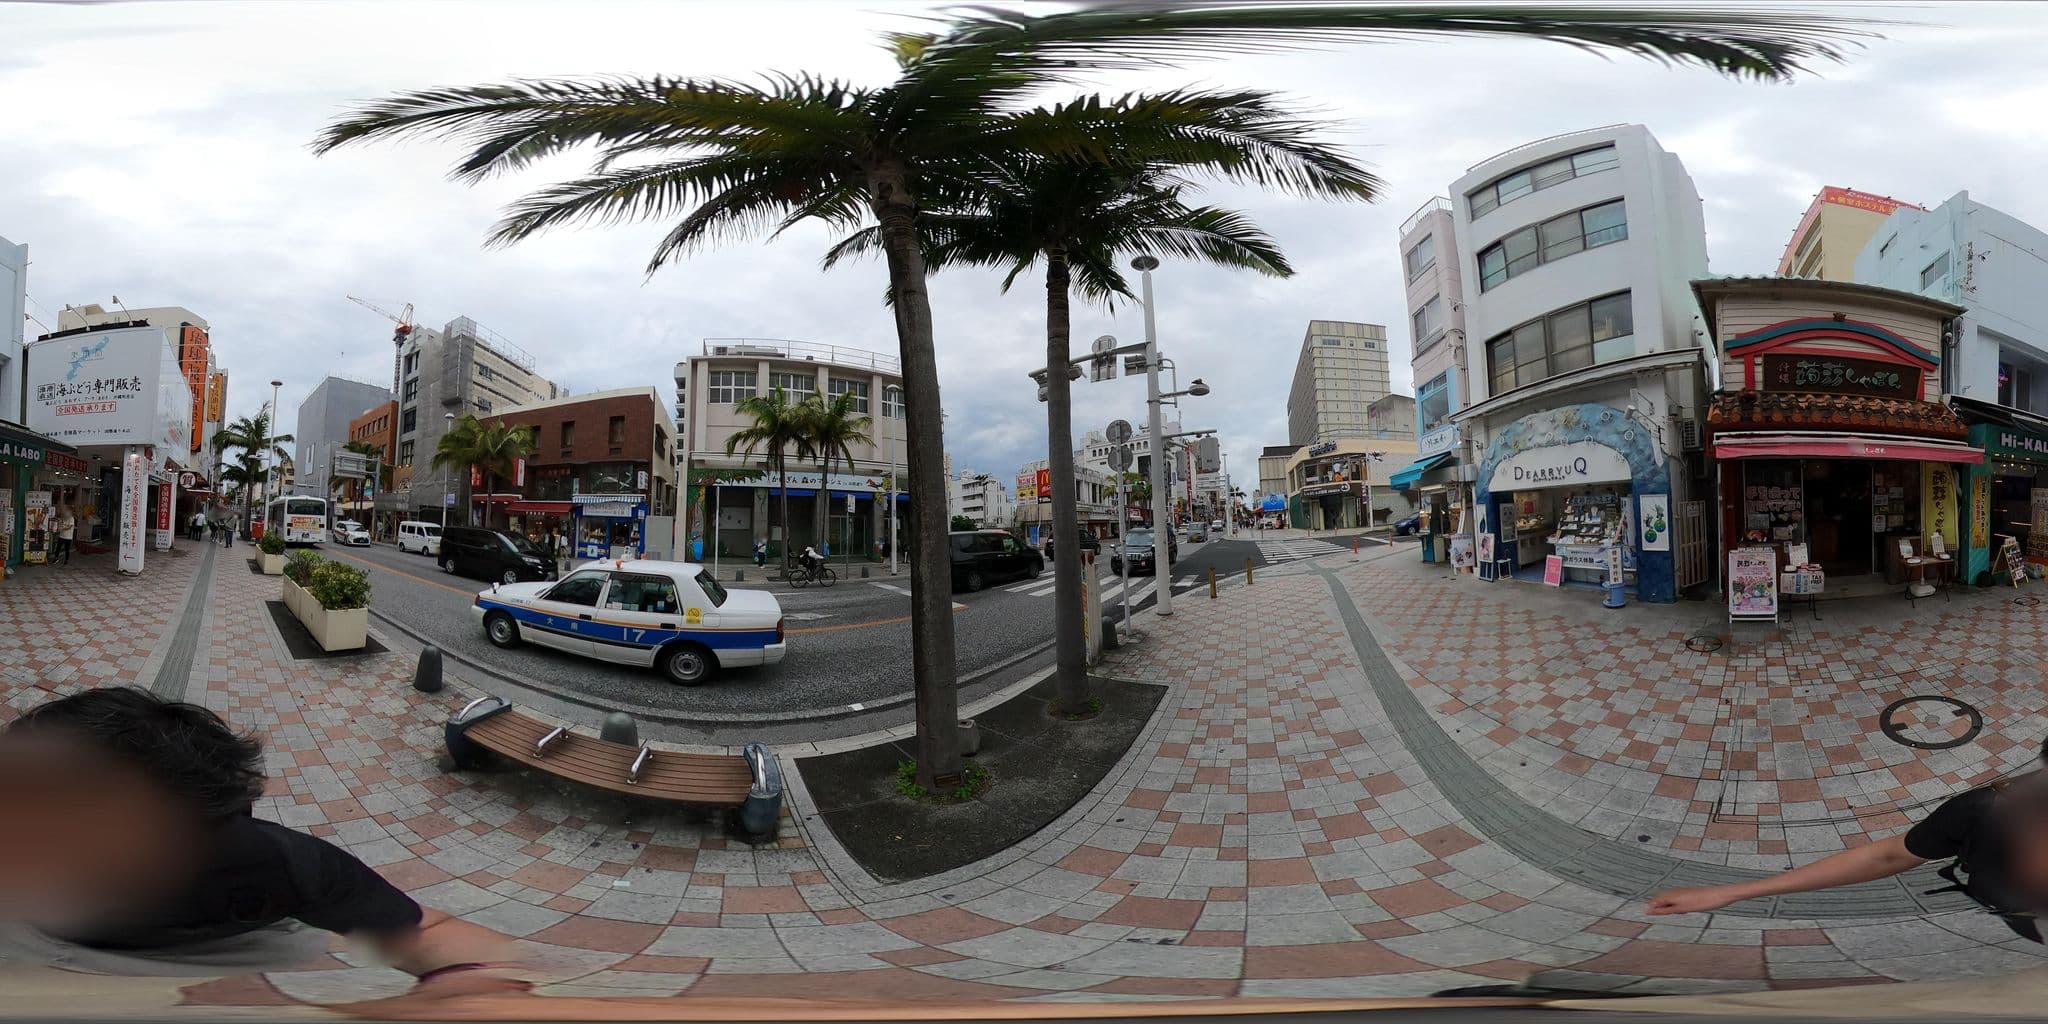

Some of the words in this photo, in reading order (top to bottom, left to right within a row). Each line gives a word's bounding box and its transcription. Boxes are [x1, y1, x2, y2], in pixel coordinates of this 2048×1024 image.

[56, 376, 141, 397] 海ぶどう専門販売
[57, 403, 115, 415] 全国発送承ります
[2001, 432, 2048, 454] Hi-KAL
[0, 443, 10, 456] A
[14, 445, 40, 461] LABO
[771, 475, 798, 485] かぎん
[801, 476, 842, 486] 森のマシェ
[623, 627, 646, 643] 17
